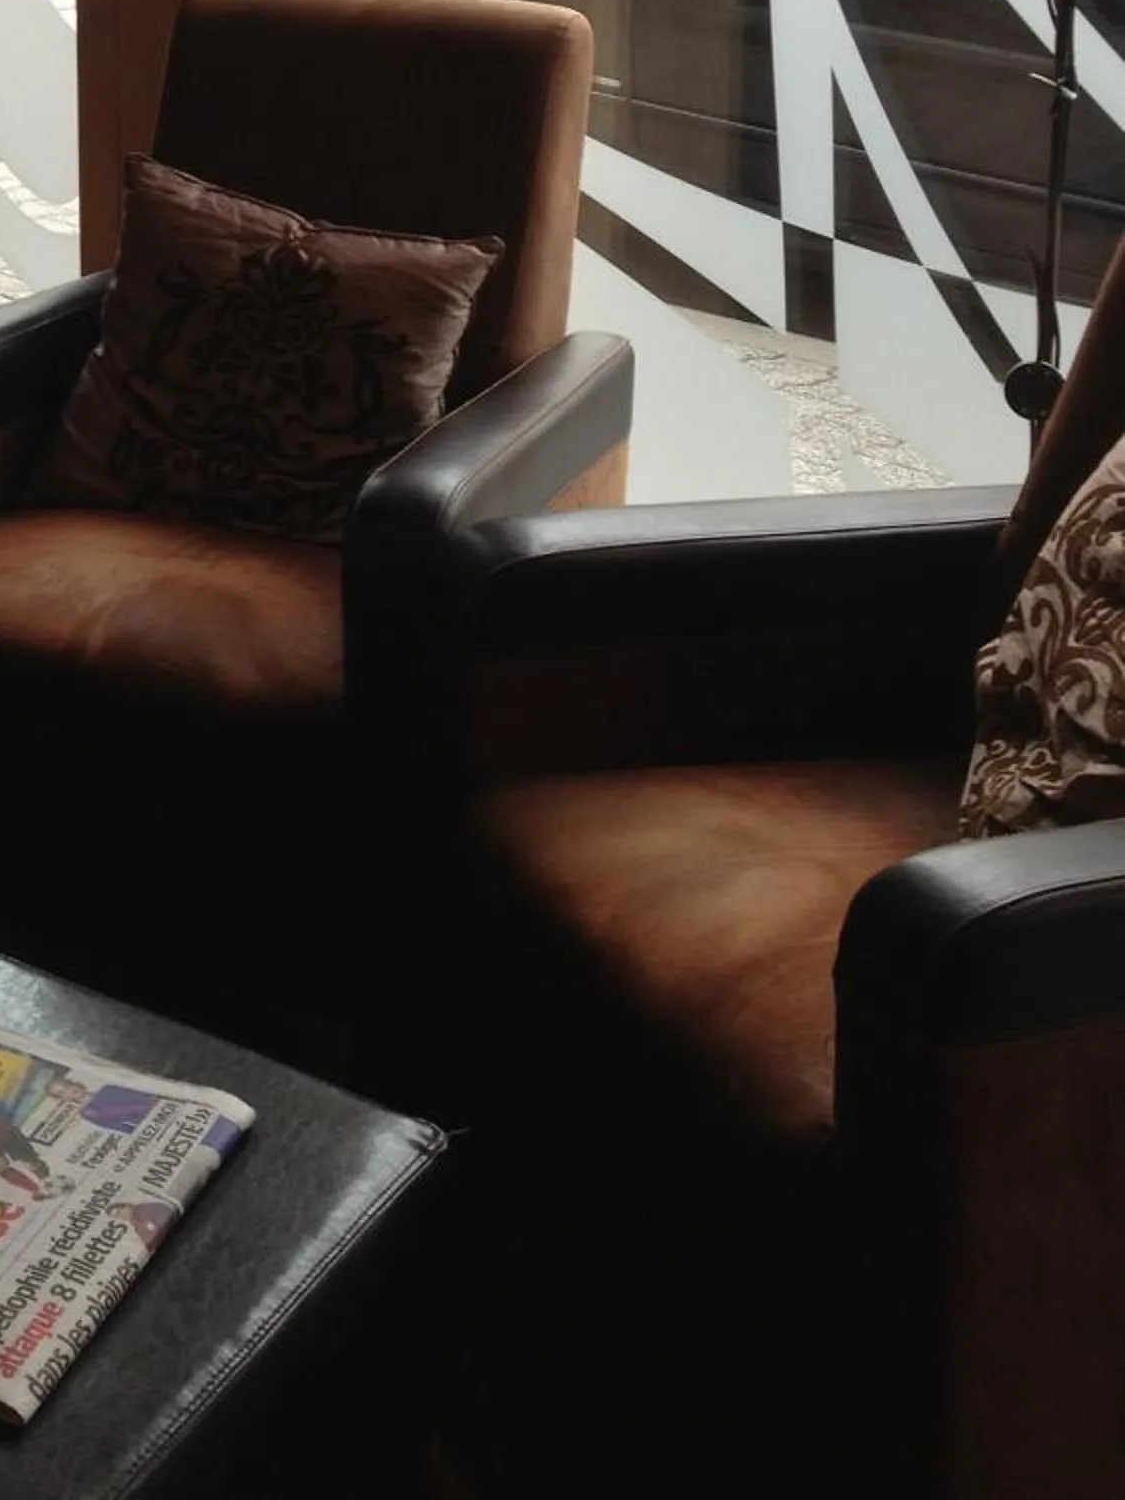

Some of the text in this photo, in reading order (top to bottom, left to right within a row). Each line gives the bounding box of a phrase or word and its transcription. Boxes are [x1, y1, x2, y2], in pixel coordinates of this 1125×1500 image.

[49, 1180, 124, 1258] récidiviste
[60, 1219, 129, 1286] fillettes
[24, 1256, 140, 1401] dans les plaines
[50, 1282, 77, 1303] 8
